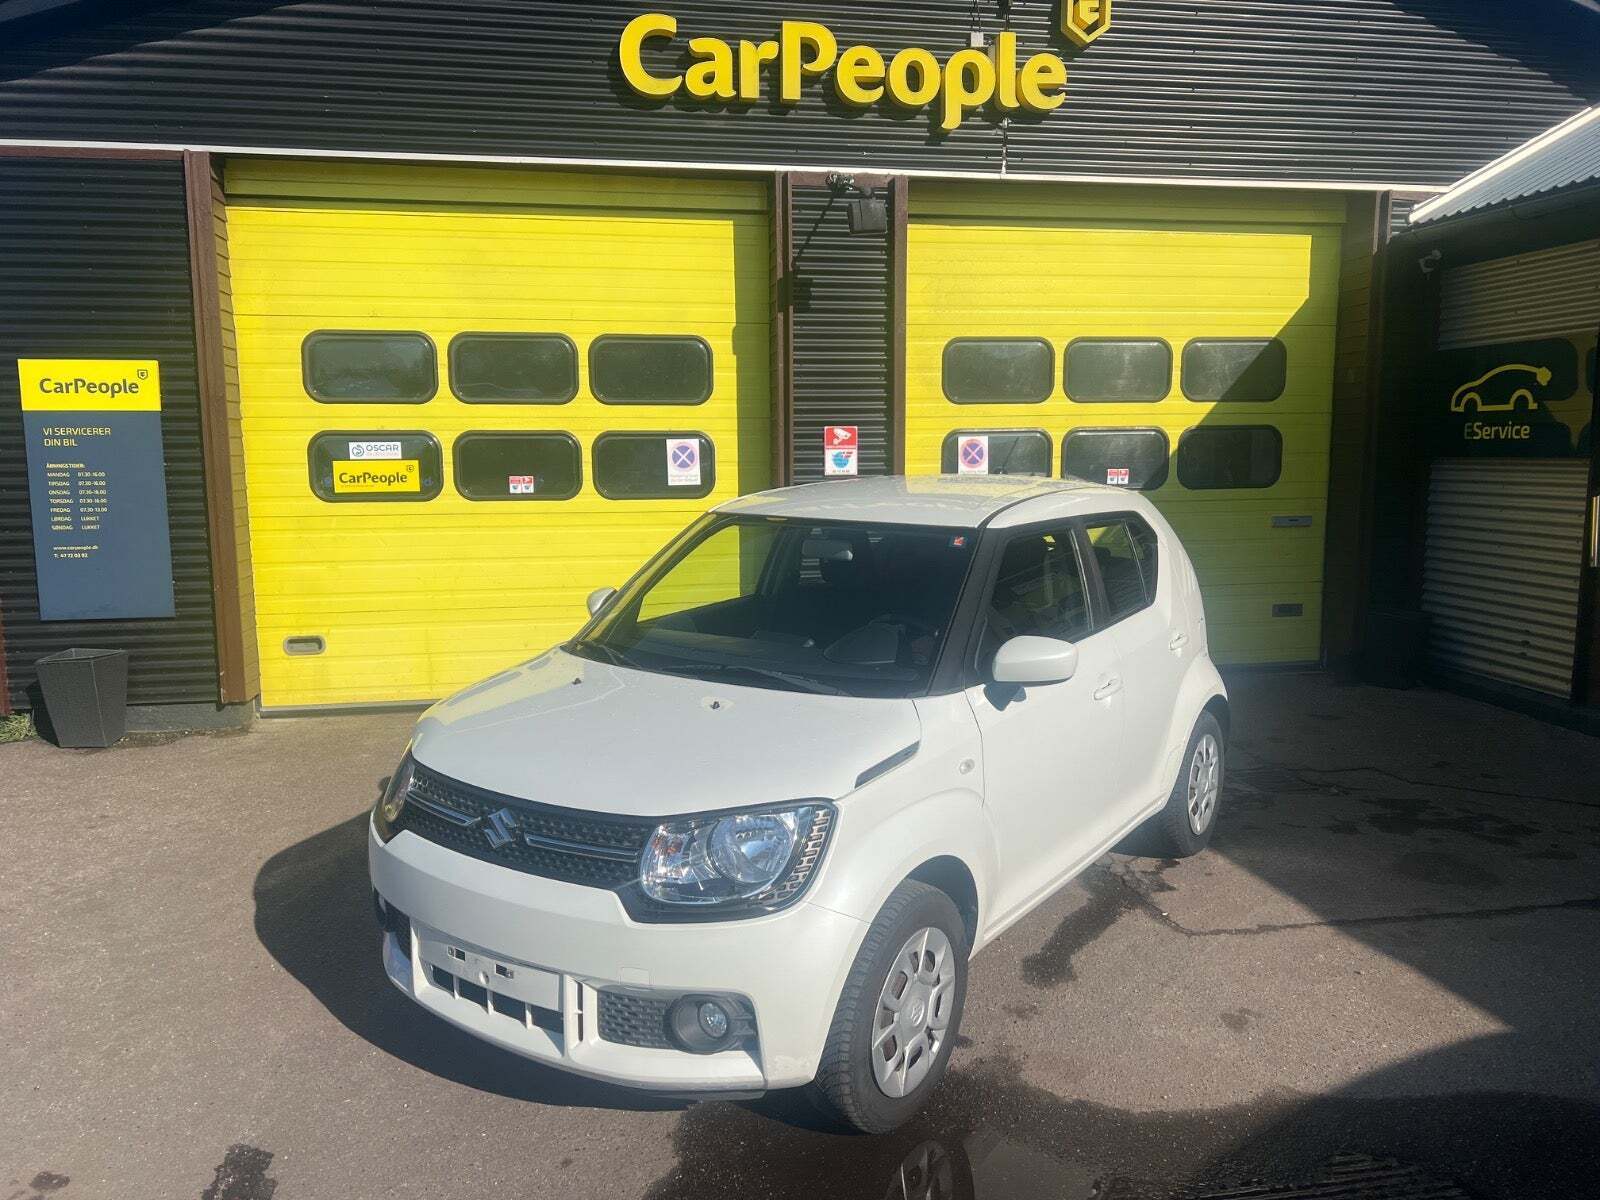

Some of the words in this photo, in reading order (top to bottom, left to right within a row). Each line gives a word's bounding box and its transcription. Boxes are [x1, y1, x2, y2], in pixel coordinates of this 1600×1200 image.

[618, 12, 1067, 131] CarPeople
[39, 378, 139, 398] CarPeople
[43, 427, 52, 436] VI
[54, 427, 111, 436] SERVICERER
[1464, 421, 1530, 440] EService
[44, 438, 61, 447] DIN
[63, 438, 78, 447] BIL
[366, 444, 399, 452] OSCAR
[339, 472, 407, 486] CarPeople
